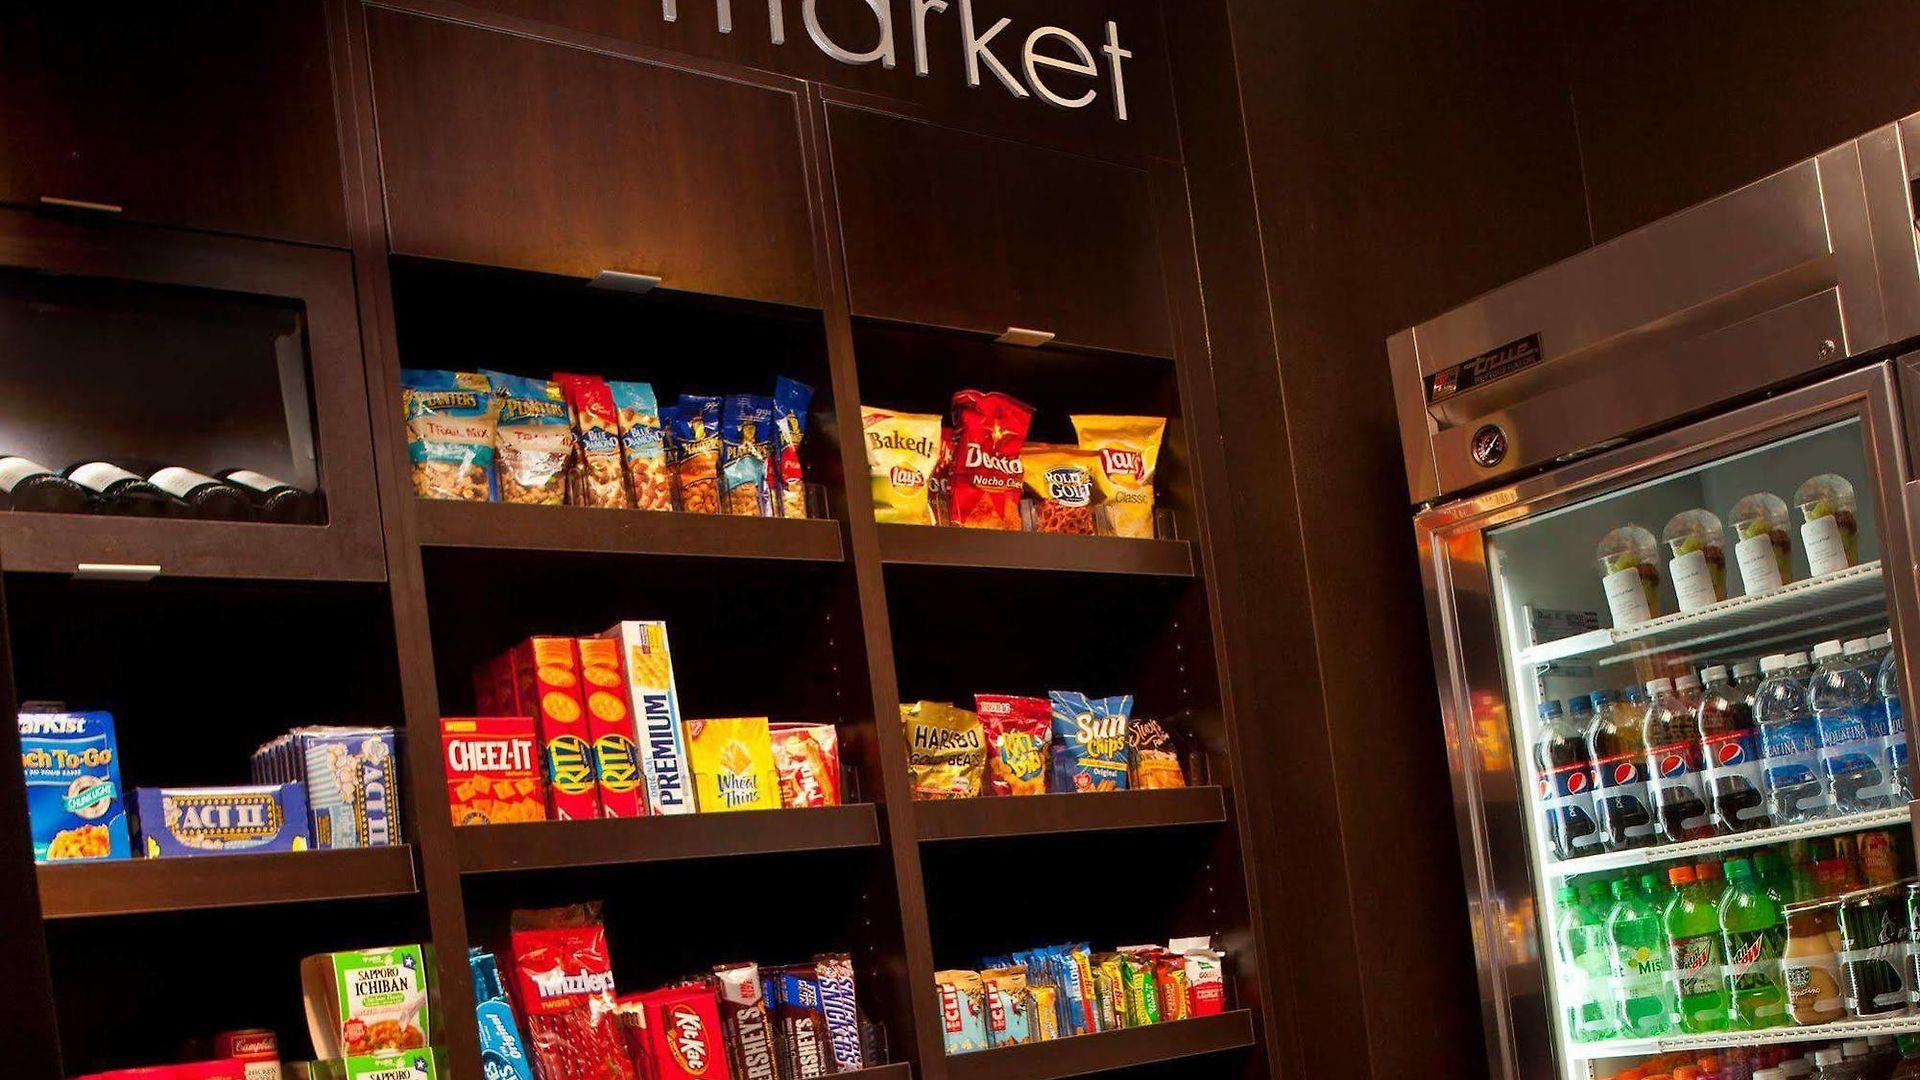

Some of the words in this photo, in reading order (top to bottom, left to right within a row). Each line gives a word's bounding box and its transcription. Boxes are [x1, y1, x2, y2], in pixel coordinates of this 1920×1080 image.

[867, 430, 933, 458] Baked!
[965, 442, 1023, 474] Dorito
[893, 466, 922, 487] Lay's
[973, 475, 1004, 486] Nacho
[18, 714, 86, 734] arKist
[914, 724, 980, 750] HARIBO
[1076, 712, 1126, 744] Sun
[449, 739, 532, 772] CHEEZ-IT
[597, 737, 637, 784] RITZ
[643, 694, 684, 806] PREMIUM
[1087, 736, 1125, 759] Chips
[551, 737, 592, 785] RITZ
[363, 765, 386, 813] ACT
[717, 771, 757, 793] Wheat
[718, 790, 760, 809] Thins
[183, 805, 232, 829] ACT
[355, 977, 409, 997] ICHIBAN
[358, 967, 399, 981] SAPPORO
[819, 976, 854, 1064] SNICKERS
